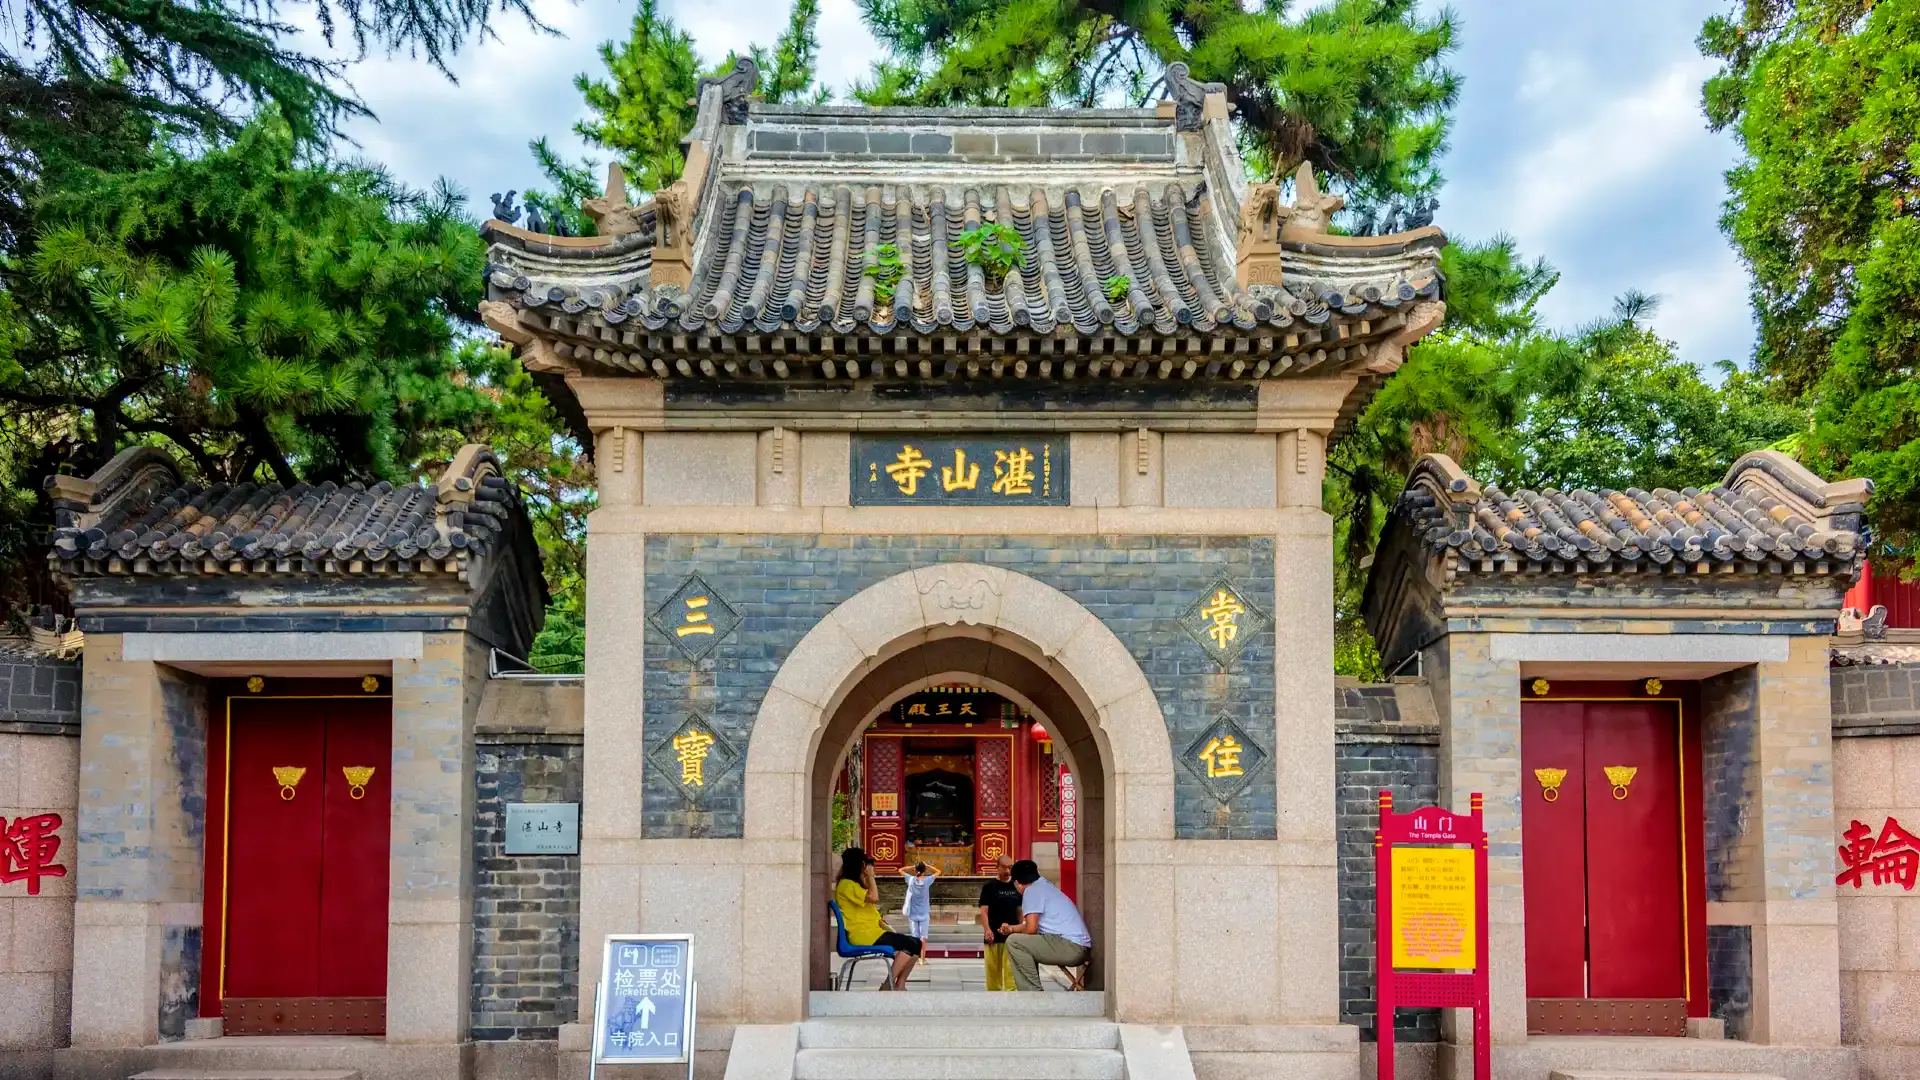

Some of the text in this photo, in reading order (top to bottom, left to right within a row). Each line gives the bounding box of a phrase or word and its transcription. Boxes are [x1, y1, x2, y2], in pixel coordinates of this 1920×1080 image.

[885, 445, 1036, 496] 湛山寺
[676, 595, 715, 637] 三
[1201, 589, 1245, 649] 常
[673, 728, 715, 786] 寶
[1199, 735, 1244, 778] 住
[522, 820, 563, 833] 湛山寺
[1414, 815, 1452, 831] 山门
[1420, 832, 1442, 840] Temple
[1835, 815, 1920, 891] 輪
[614, 968, 681, 989] 检票处
[614, 987, 681, 996] Tickets Check
[610, 1031, 678, 1047] 寺院入口
